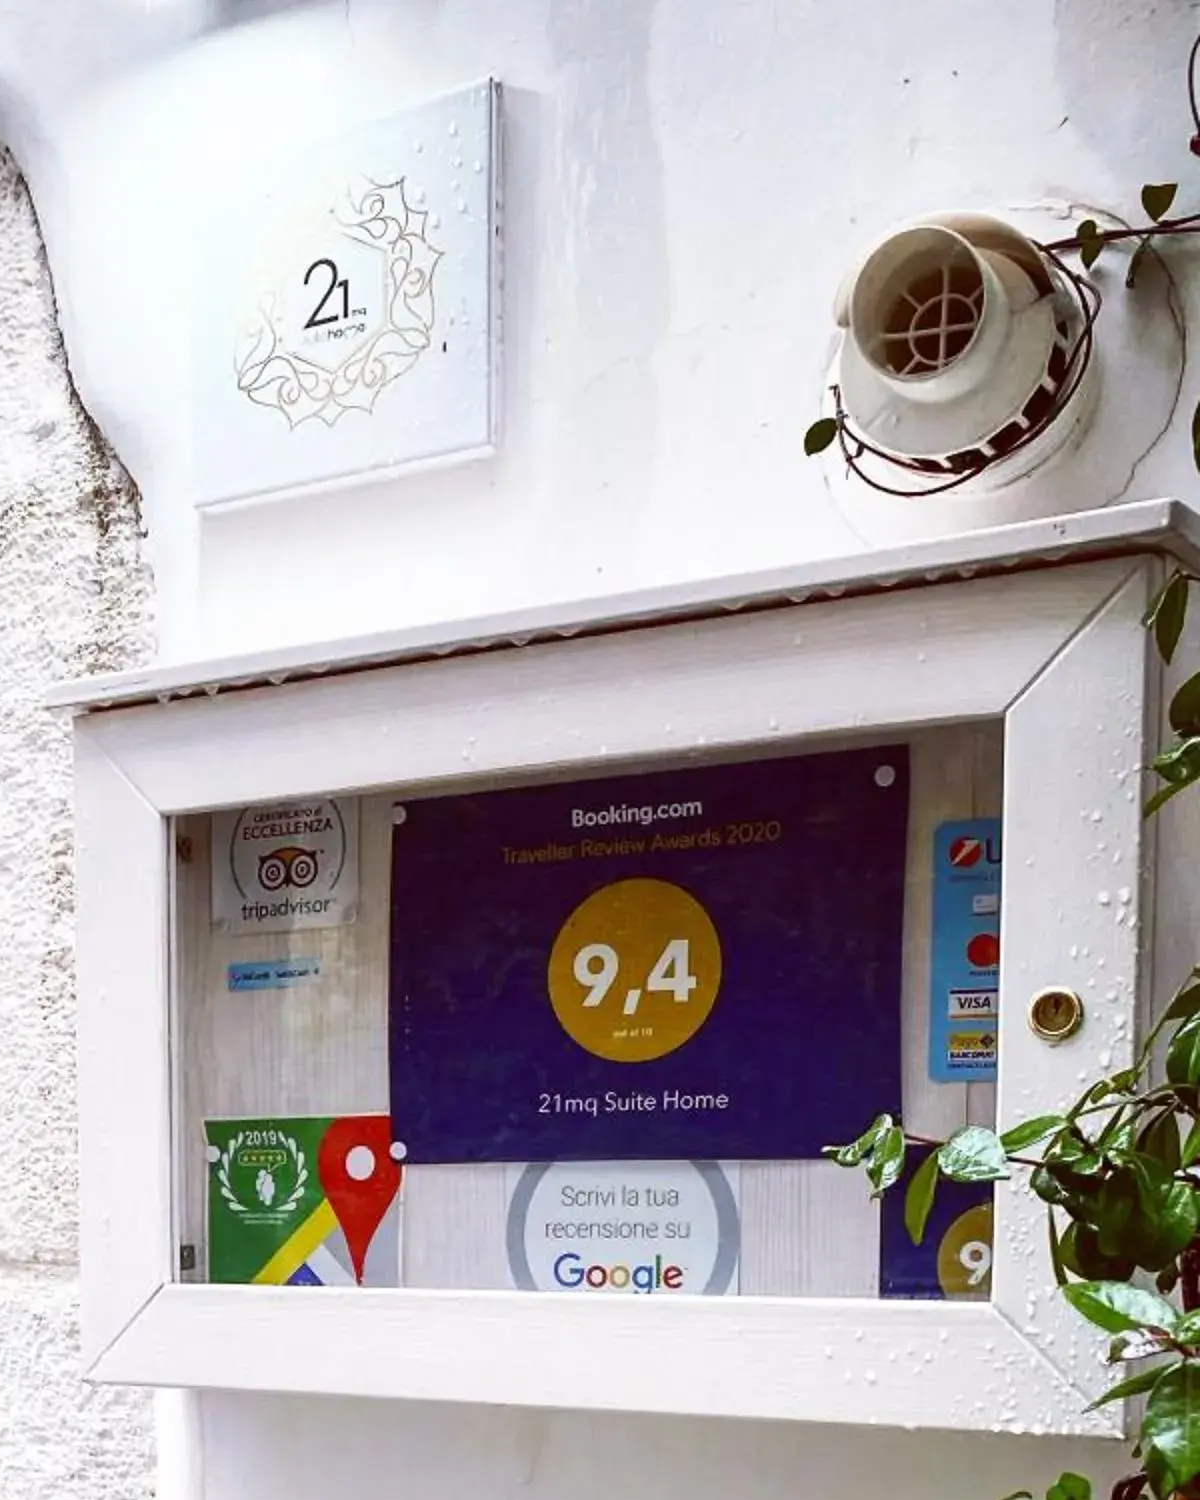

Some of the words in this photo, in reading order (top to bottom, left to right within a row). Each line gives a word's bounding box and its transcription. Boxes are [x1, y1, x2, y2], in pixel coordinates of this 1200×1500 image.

[302, 257, 350, 330] 21
[571, 801, 703, 828] Booking.com
[242, 817, 334, 841] ECCELLENZA
[502, 842, 576, 864] Traveller
[580, 838, 645, 858] Review
[650, 828, 721, 850] Awards
[726, 820, 781, 845] 2020
[241, 898, 331, 922] tripadvisor
[572, 939, 697, 1016] 9,4
[957, 996, 991, 1009] VISA
[538, 1093, 598, 1117] 21mq
[605, 1091, 657, 1111] Suite
[663, 1090, 729, 1110] Home
[246, 1131, 277, 1146] 2019
[560, 1186, 616, 1207] Scrivi
[622, 1186, 639, 1207] la
[645, 1188, 680, 1207] tua
[545, 1218, 658, 1239] recensione
[664, 1220, 690, 1239] su
[553, 1252, 684, 1293] Google
